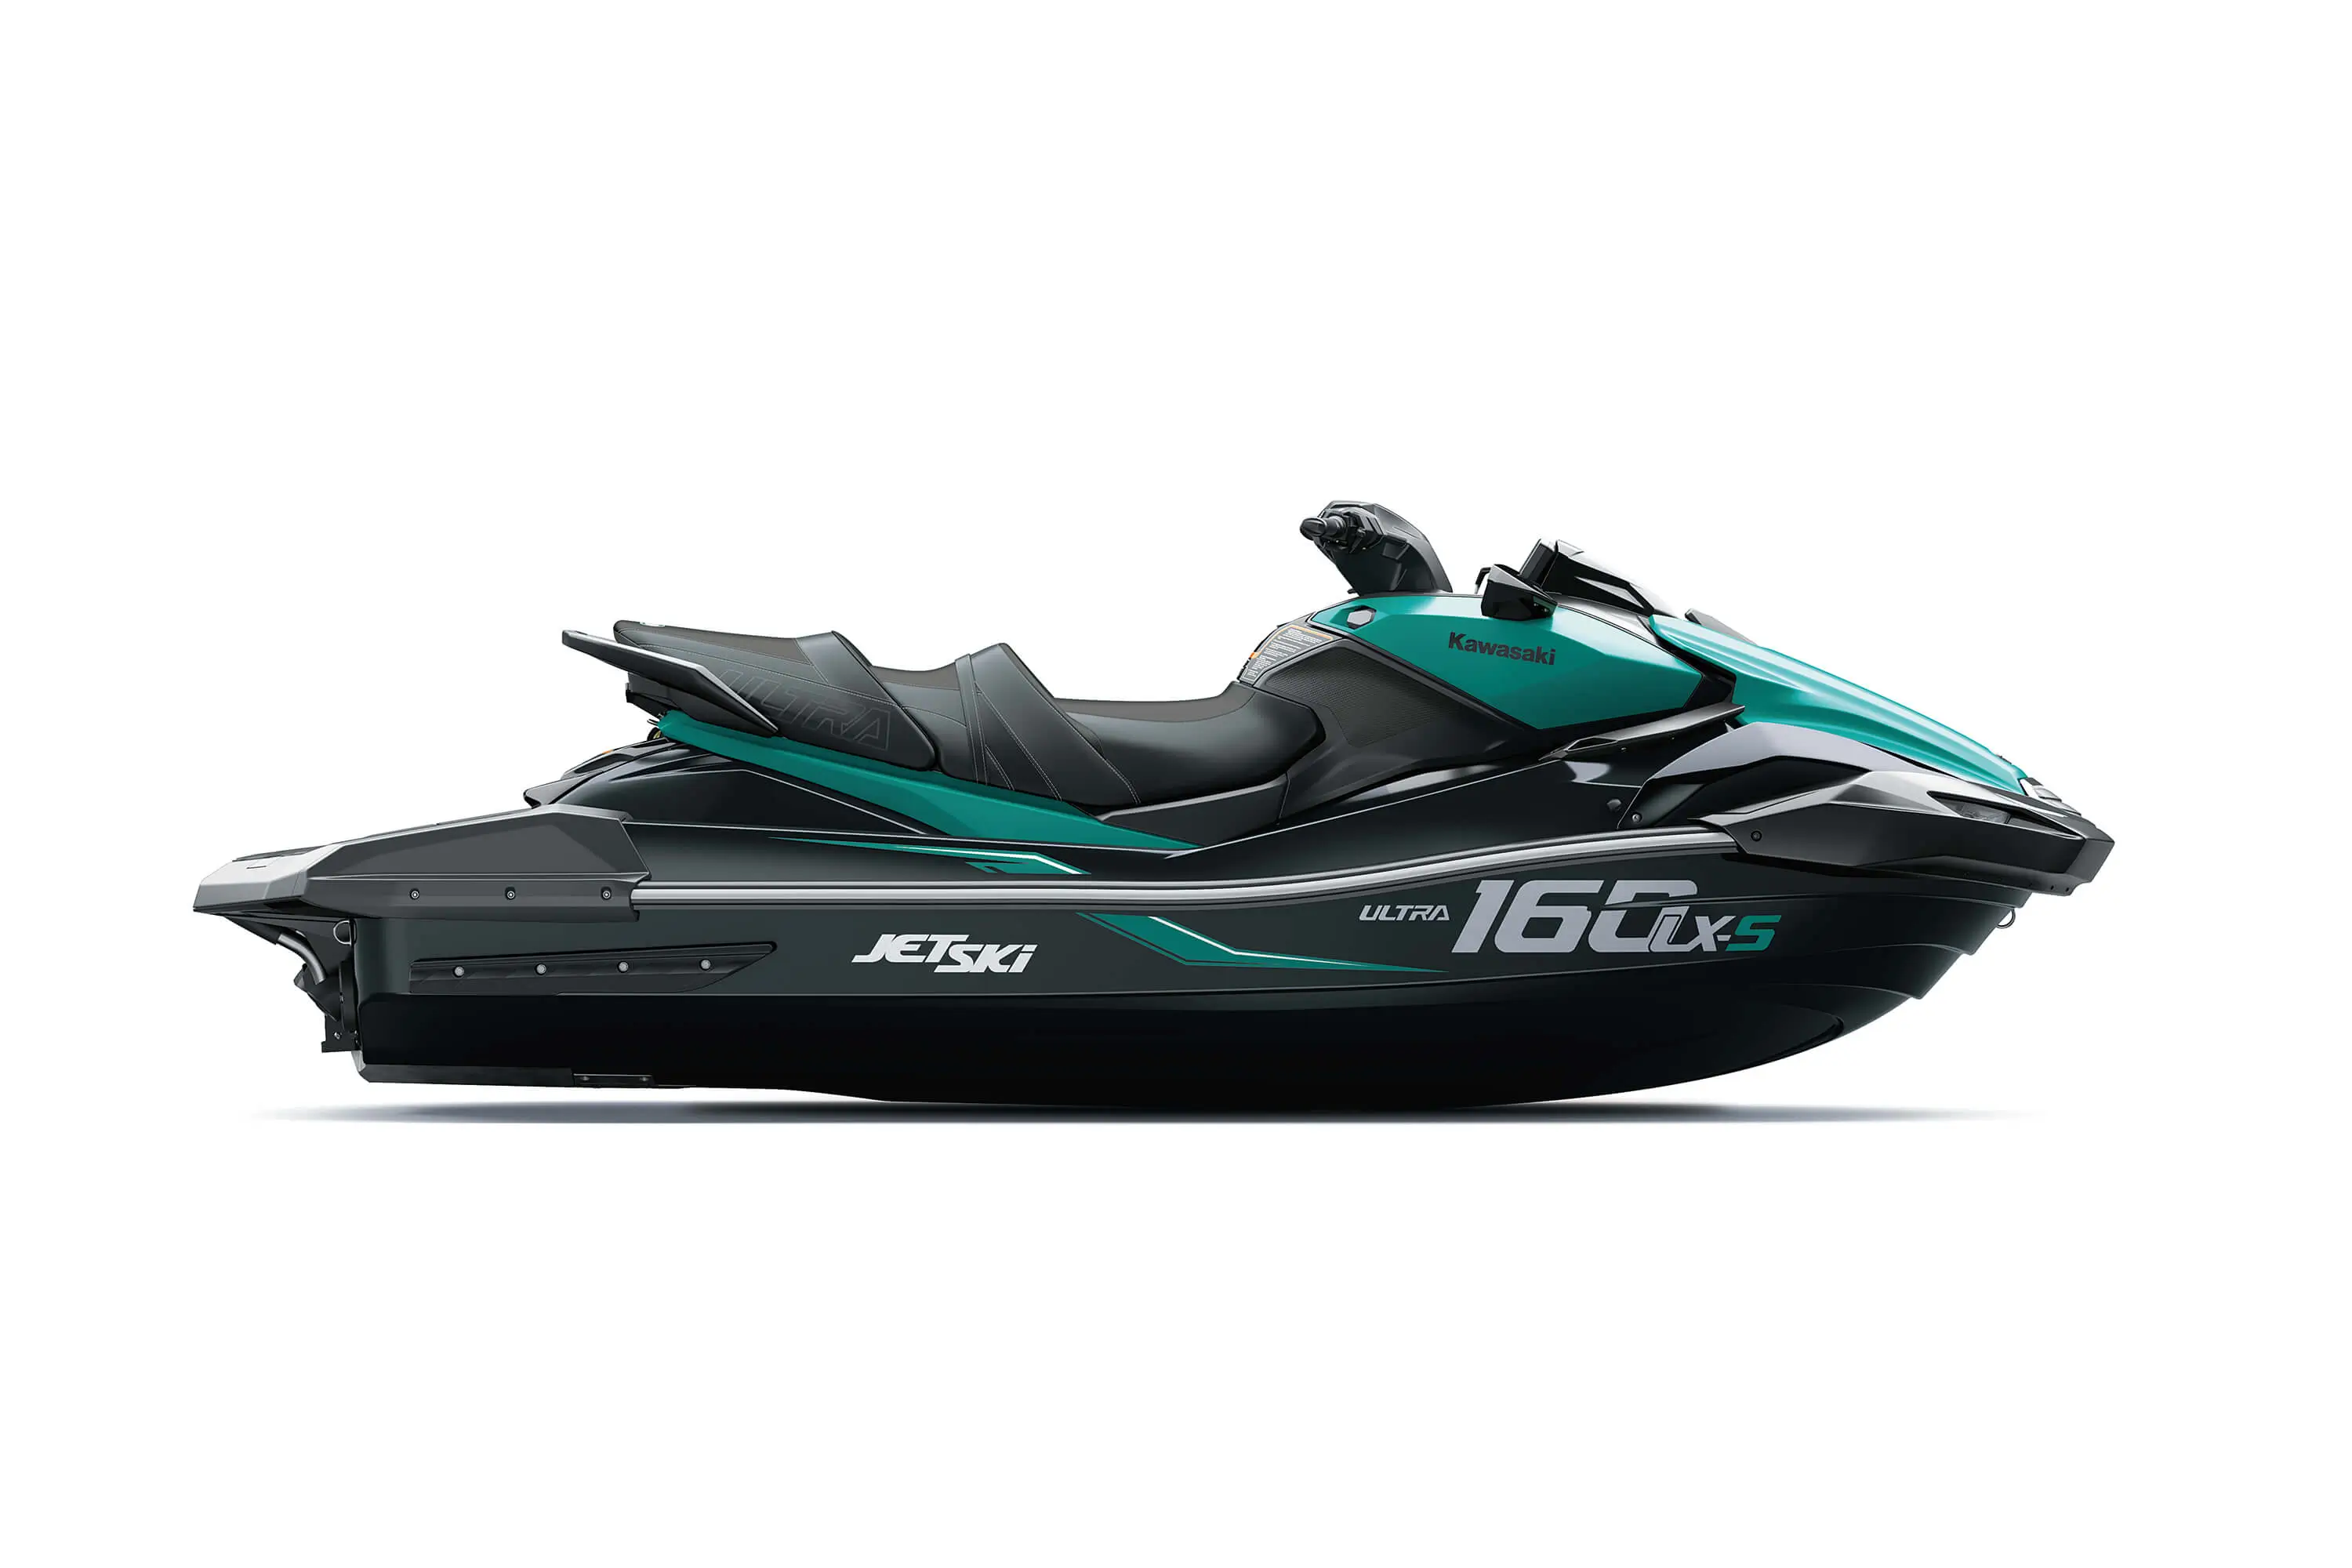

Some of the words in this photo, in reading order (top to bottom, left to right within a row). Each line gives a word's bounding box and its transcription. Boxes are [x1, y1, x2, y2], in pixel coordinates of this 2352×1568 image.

[1448, 631, 1556, 666] Kawasaki
[1359, 905, 1450, 921] ULTRA
[1451, 880, 1698, 953] 160
[851, 934, 970, 963] JET
